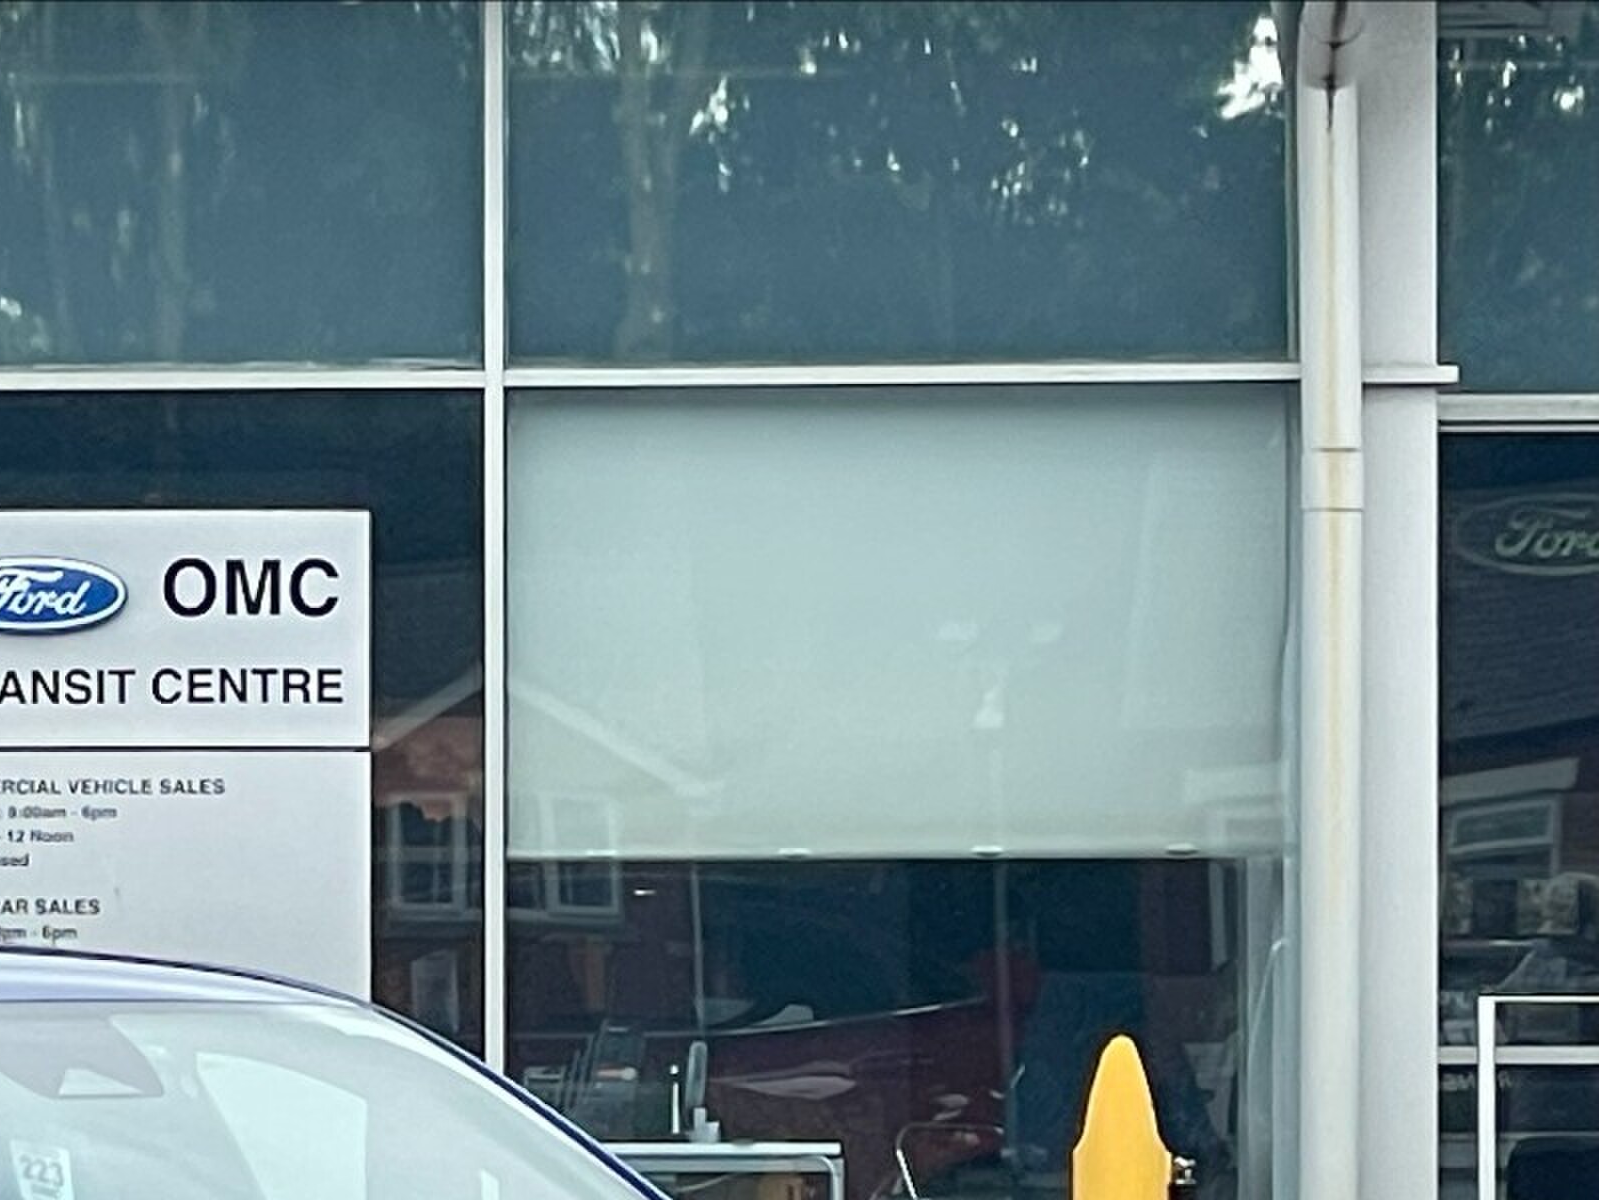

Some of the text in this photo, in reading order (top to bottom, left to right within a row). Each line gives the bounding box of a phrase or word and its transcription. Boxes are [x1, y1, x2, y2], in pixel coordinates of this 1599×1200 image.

[162, 557, 340, 617] OMC
[151, 668, 345, 705] CENTRE
[68, 779, 153, 795] VEHICLE
[159, 778, 226, 795] SALES
[7, 829, 25, 842] 12
[30, 829, 74, 842] Noon
[35, 898, 101, 915] SALES
